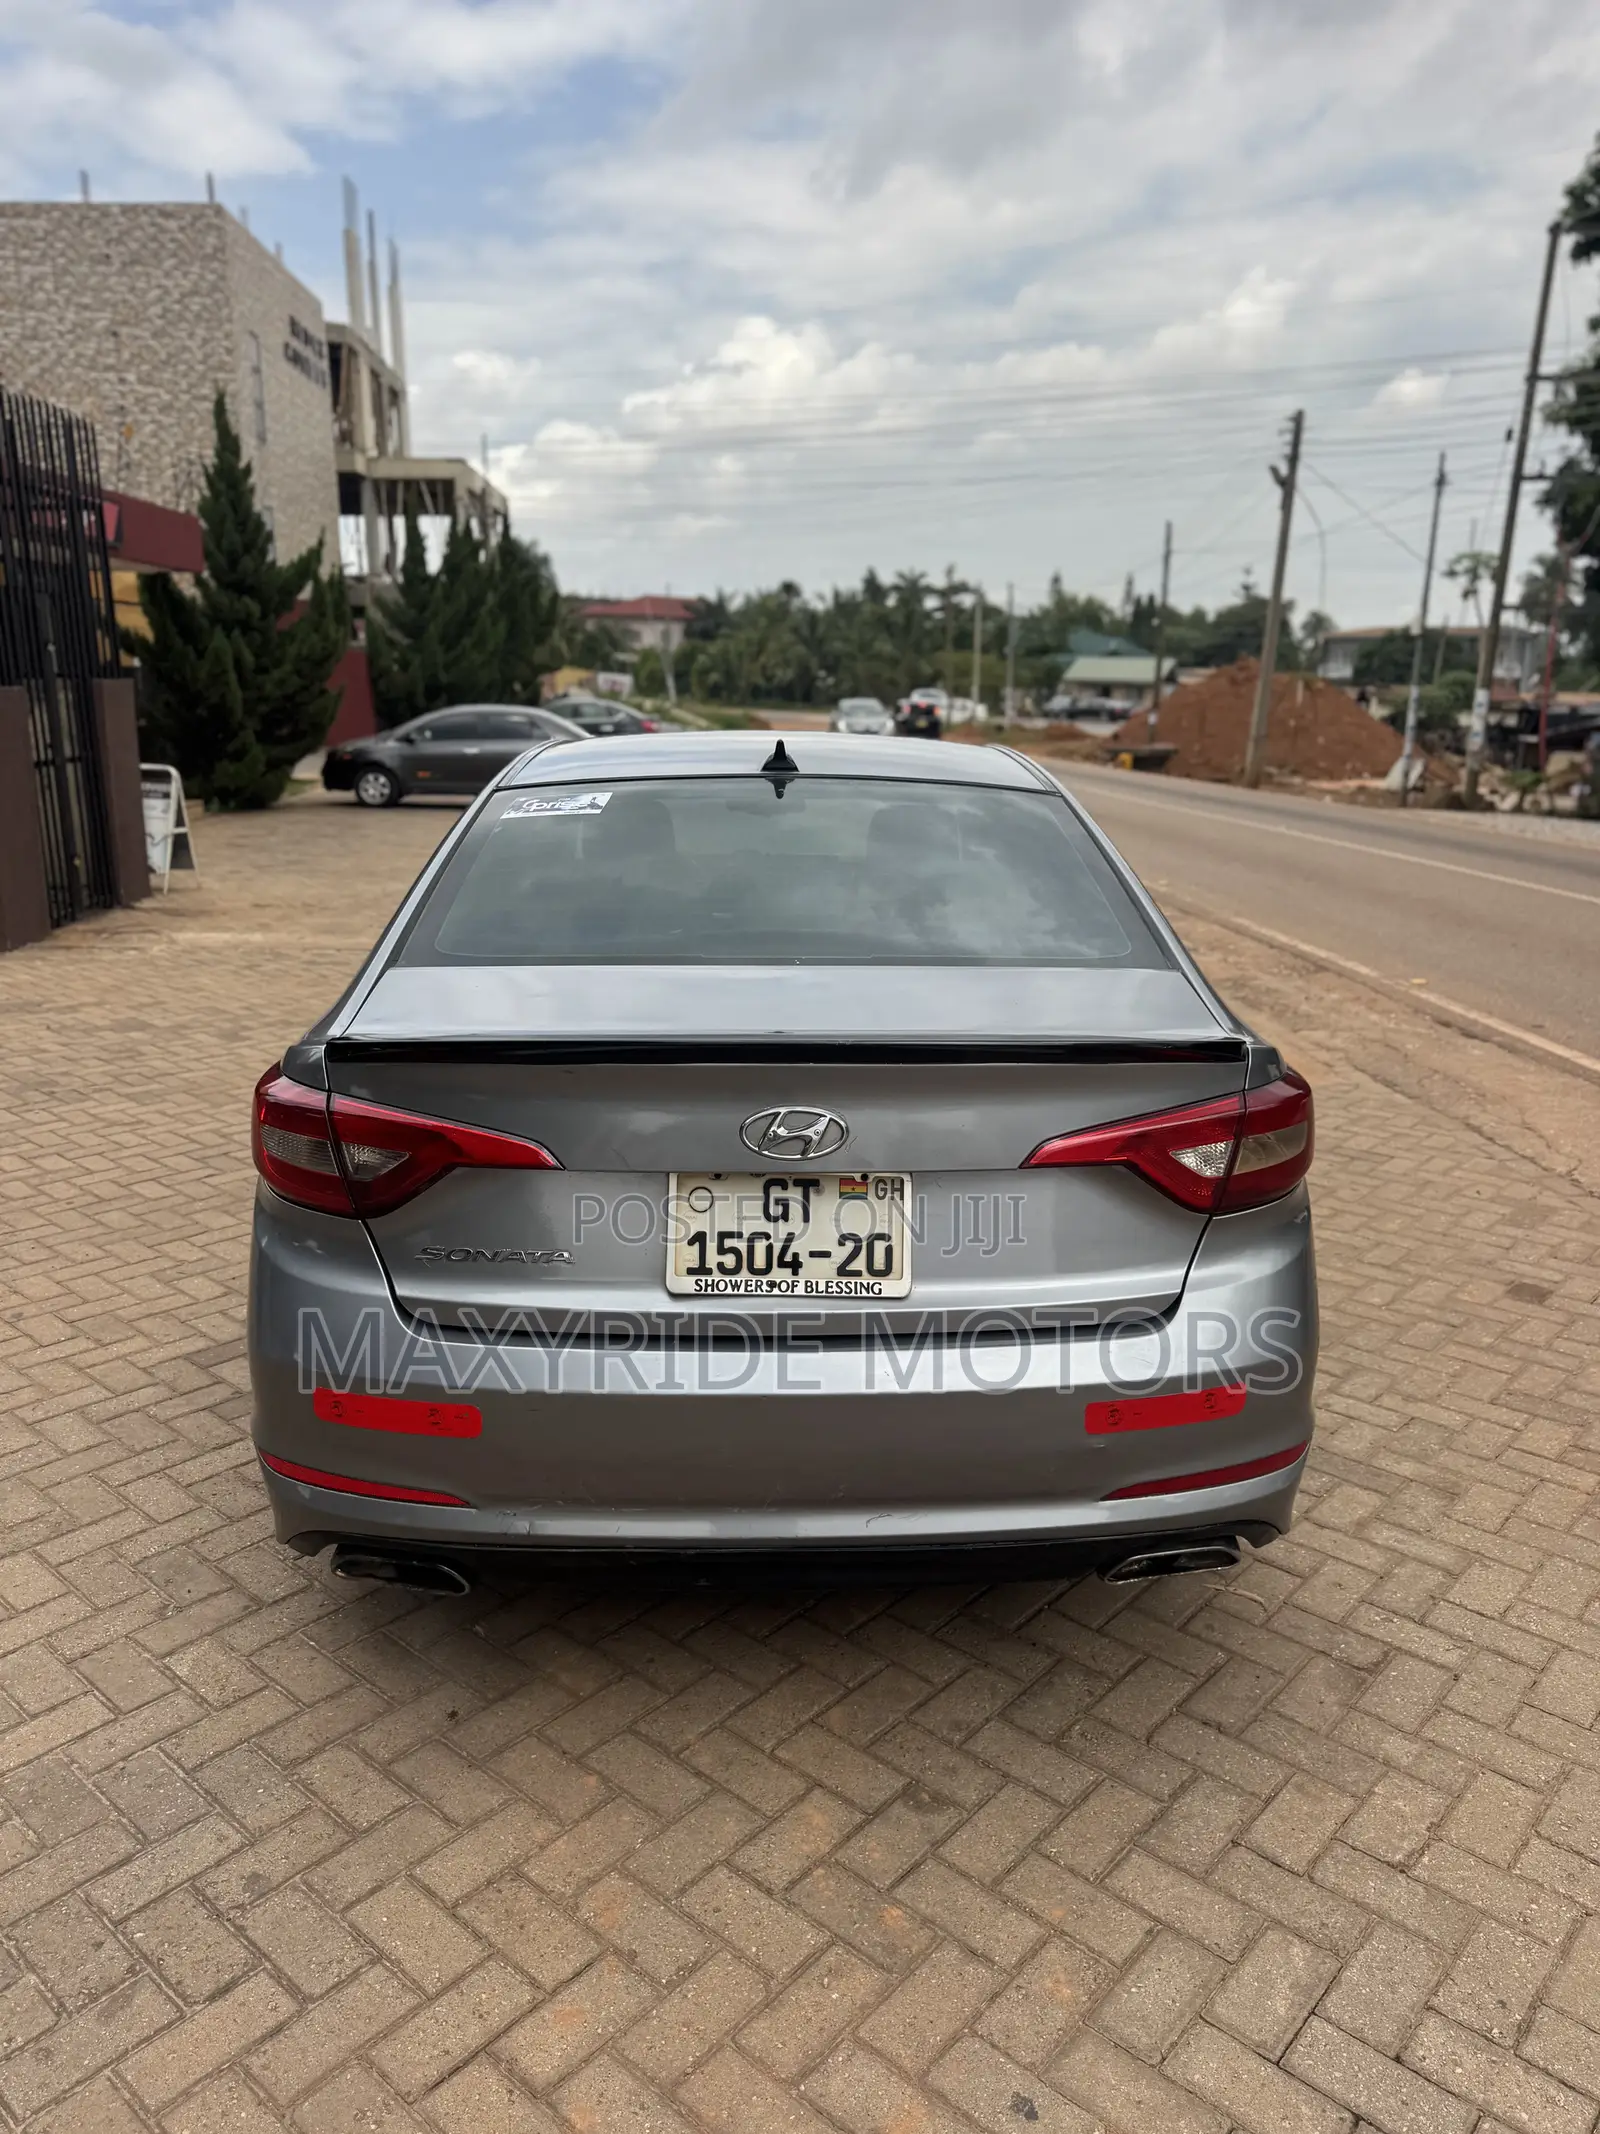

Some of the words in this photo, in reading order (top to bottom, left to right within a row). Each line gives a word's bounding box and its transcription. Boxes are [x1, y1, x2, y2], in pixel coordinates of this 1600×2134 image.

[763, 1178, 820, 1223] GT
[874, 1178, 904, 1201] GH
[414, 1245, 576, 1267] SONATA
[686, 1231, 894, 1278] 1504-20
[777, 1280, 800, 1294] OF
[804, 1281, 882, 1296] BLESSING
